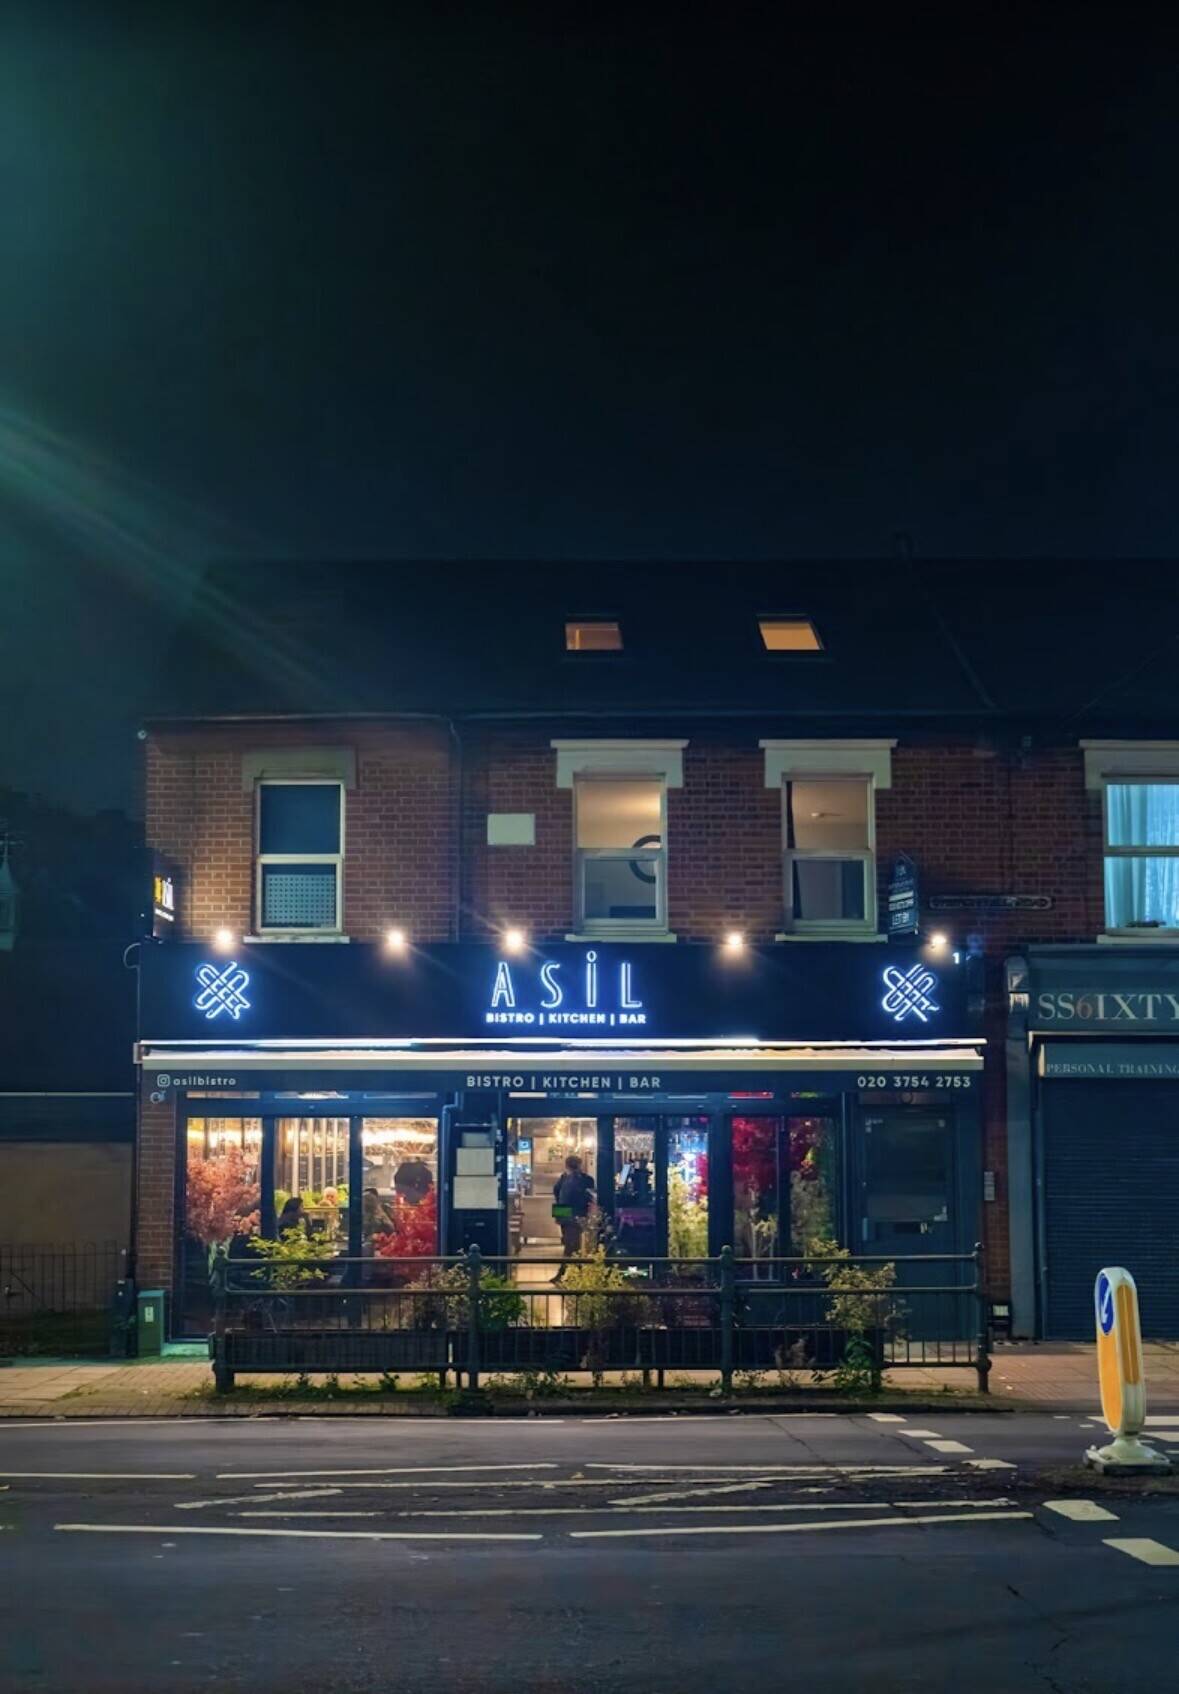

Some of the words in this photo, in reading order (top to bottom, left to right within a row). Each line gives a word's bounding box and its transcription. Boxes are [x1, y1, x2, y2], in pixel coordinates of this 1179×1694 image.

[486, 1013, 535, 1024] BISTRO
[548, 1013, 606, 1024] KITCHEN
[619, 1014, 647, 1025] BAR
[1046, 1063, 1115, 1075] PERSONAL
[173, 1075, 237, 1086] asilbistro
[466, 1075, 525, 1087] BISTRO
[543, 1076, 612, 1088] KITCHEN
[629, 1077, 661, 1088] BAR
[857, 1076, 886, 1088] 020
[893, 1076, 930, 1088] 3754
[935, 1076, 972, 1088] 2753
